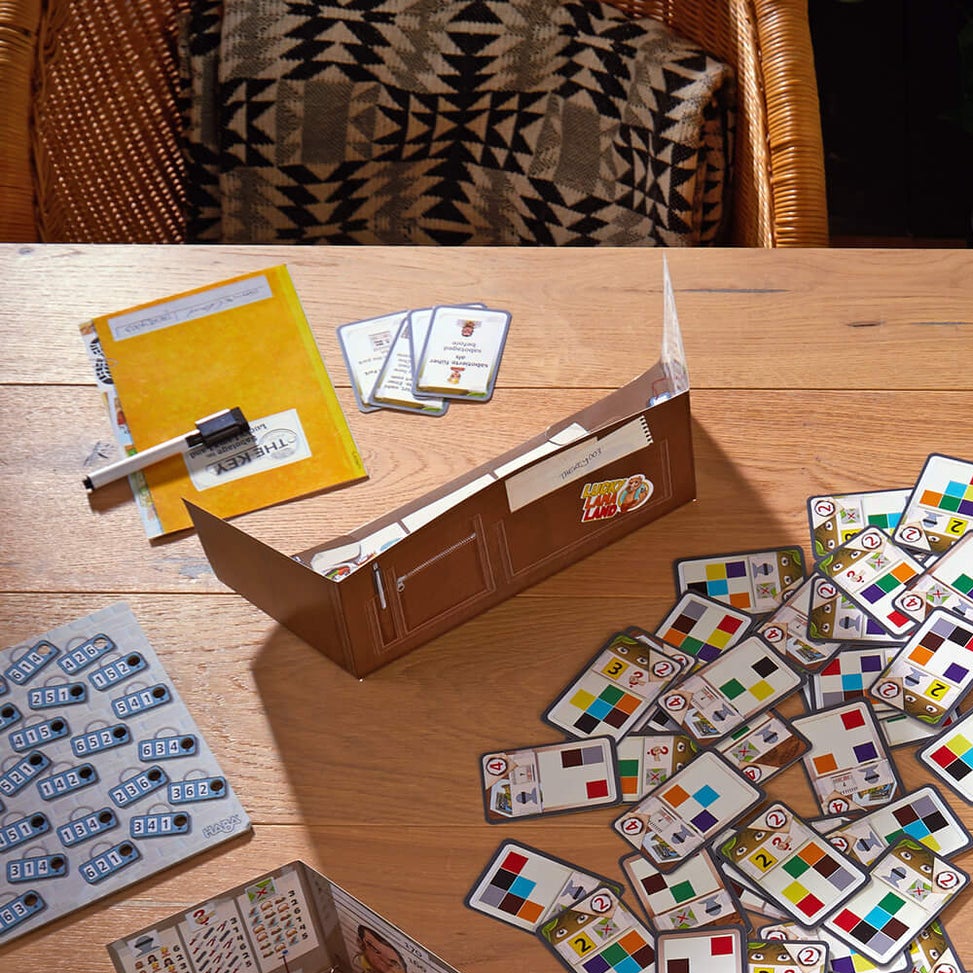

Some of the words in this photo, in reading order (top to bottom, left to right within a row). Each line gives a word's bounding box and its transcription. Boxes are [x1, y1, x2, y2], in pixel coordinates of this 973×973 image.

[255, 438, 288, 459] THE
[216, 453, 252, 475] KEY
[583, 480, 626, 498] LUCKY
[583, 505, 618, 521] LAND
[819, 504, 831, 513] 2
[906, 526, 920, 540] 2
[952, 521, 962, 532] 2
[906, 598, 918, 608] 4
[64, 646, 96, 670] 426
[12, 654, 41, 679] 614
[95, 663, 128, 685] 152
[608, 663, 622, 674] 3
[656, 661, 669, 677] 2
[34, 691, 66, 703] 251
[931, 684, 944, 696] 2
[117, 694, 151, 713] 541
[668, 697, 681, 707] 4
[15, 727, 49, 744] 415
[76, 733, 111, 751] 652
[143, 741, 178, 755] 634
[1, 765, 31, 791] 521
[43, 774, 77, 794] 142
[115, 778, 149, 802] 236
[173, 784, 207, 799] 362
[63, 819, 98, 841] 134
[134, 819, 170, 832] 341
[625, 820, 638, 831] 4
[86, 853, 120, 878] 621
[756, 854, 772, 867] 2
[11, 861, 47, 876] 314
[938, 874, 954, 889] 2
[575, 939, 591, 952] 2
[804, 950, 814, 962] 2
